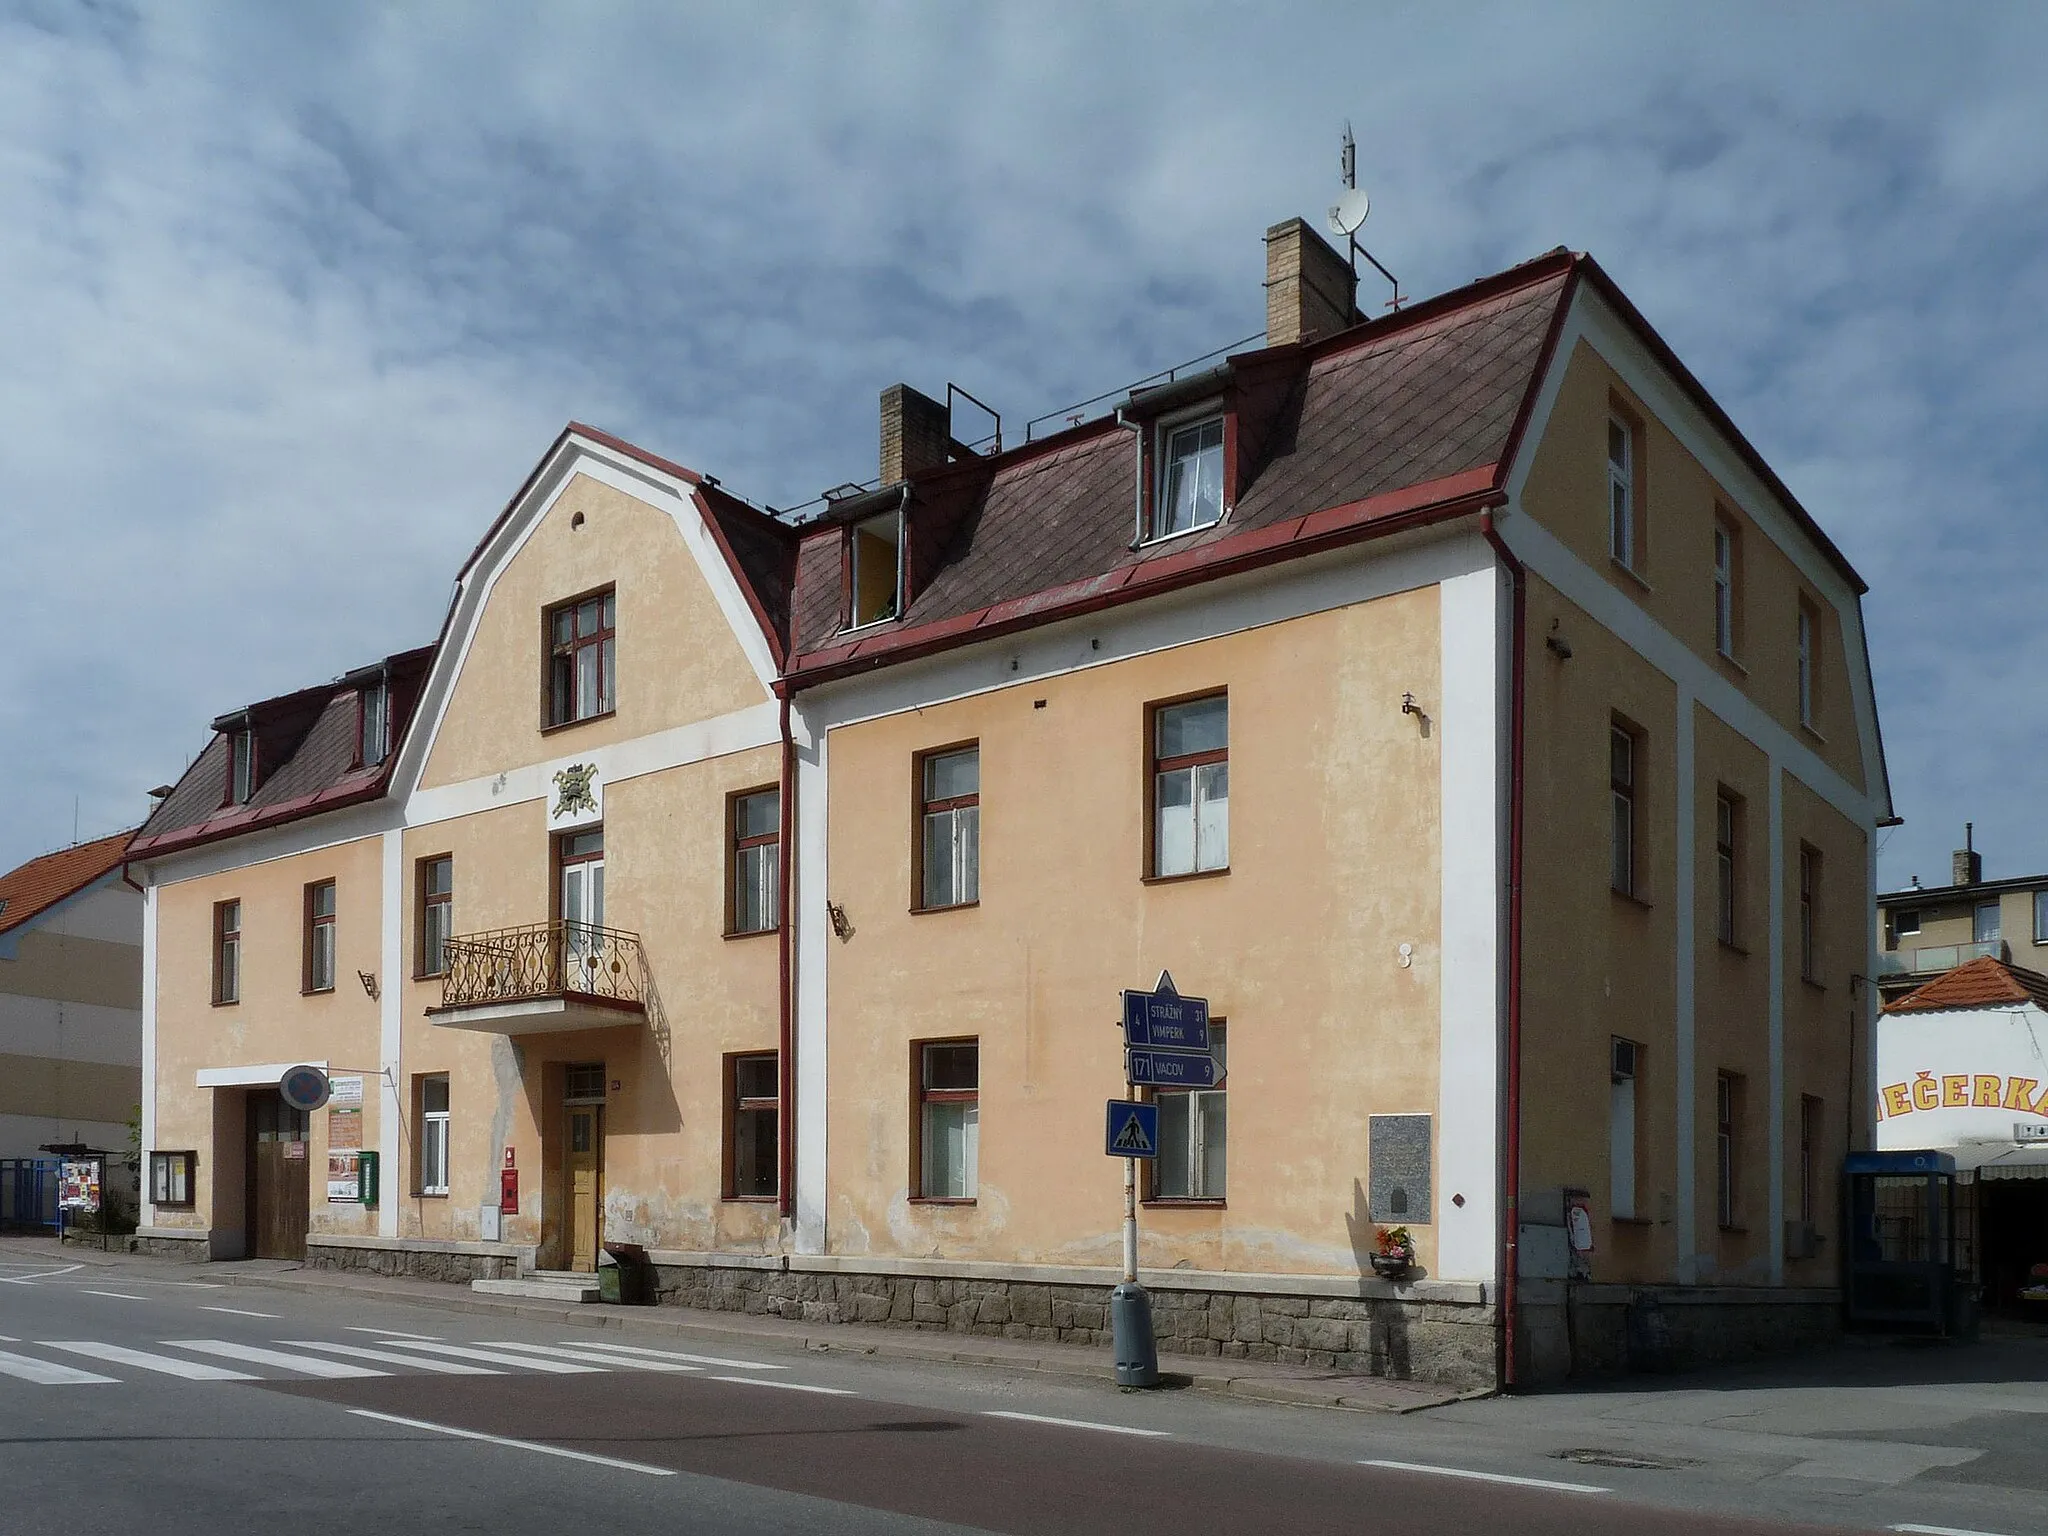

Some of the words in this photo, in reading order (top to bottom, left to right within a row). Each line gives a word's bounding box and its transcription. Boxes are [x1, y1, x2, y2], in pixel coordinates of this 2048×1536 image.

[1135, 1014, 1140, 1026] 4
[1151, 1004, 1183, 1020] STRÁŽNÝ
[1195, 1010, 1204, 1022] 31
[1152, 1025, 1184, 1040] VIMPERK
[1199, 1031, 1204, 1042] 9
[1133, 1057, 1150, 1076] 171
[1155, 1062, 1184, 1077] VACOV
[1205, 1066, 1210, 1077] 9
[1877, 1070, 2048, 1122] EČERK
